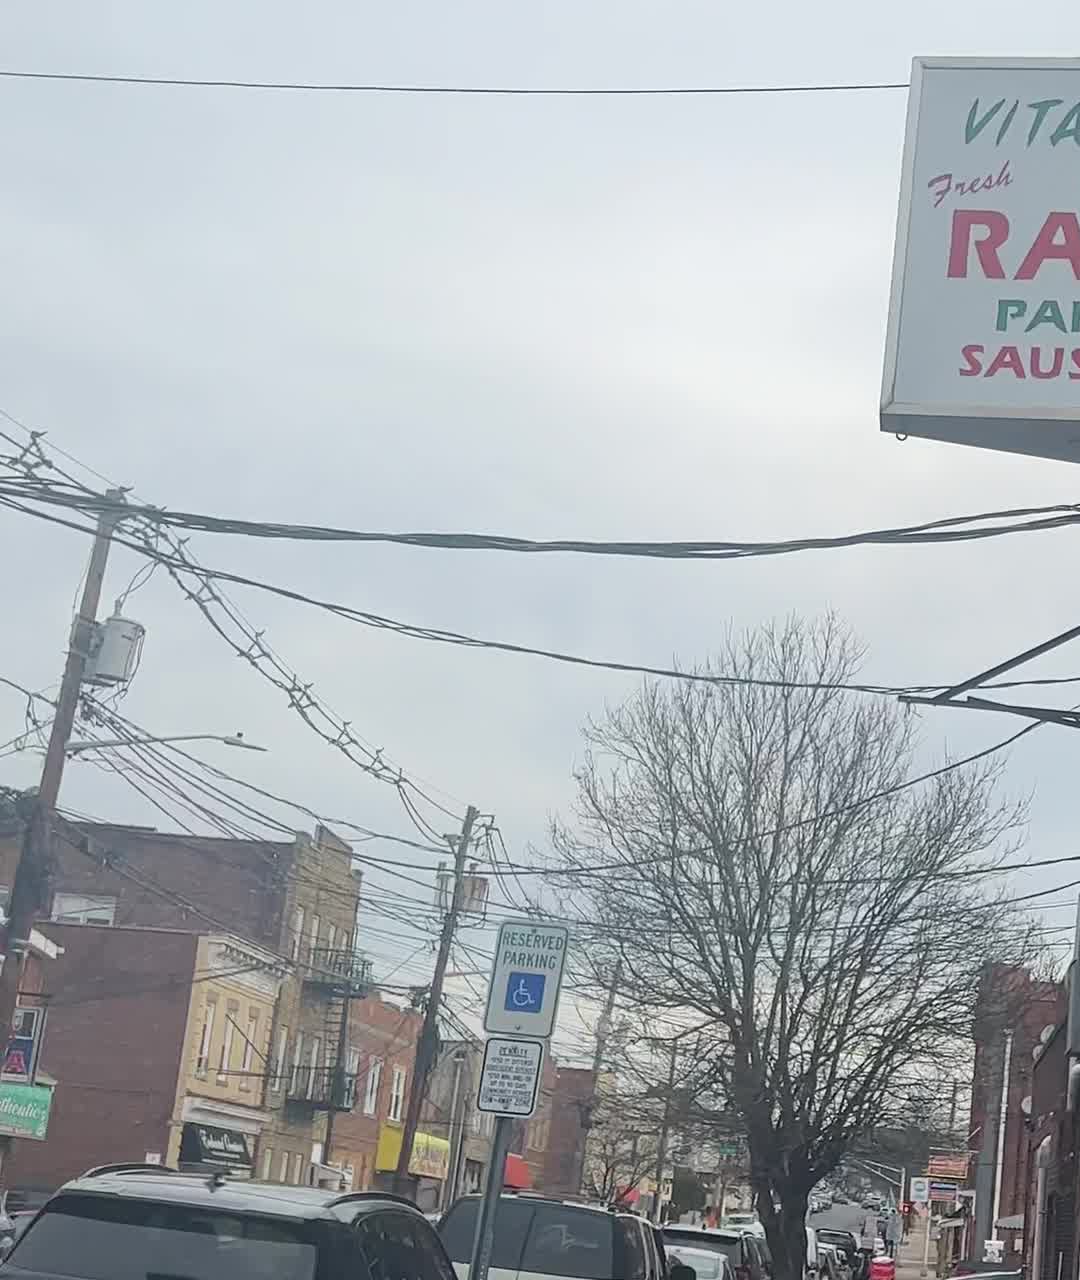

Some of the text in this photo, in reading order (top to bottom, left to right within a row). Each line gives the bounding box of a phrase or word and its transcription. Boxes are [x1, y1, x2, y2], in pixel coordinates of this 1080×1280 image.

[928, 160, 1014, 208] Fresh
[503, 931, 564, 951] RESERVED
[503, 951, 558, 970] PARKING
